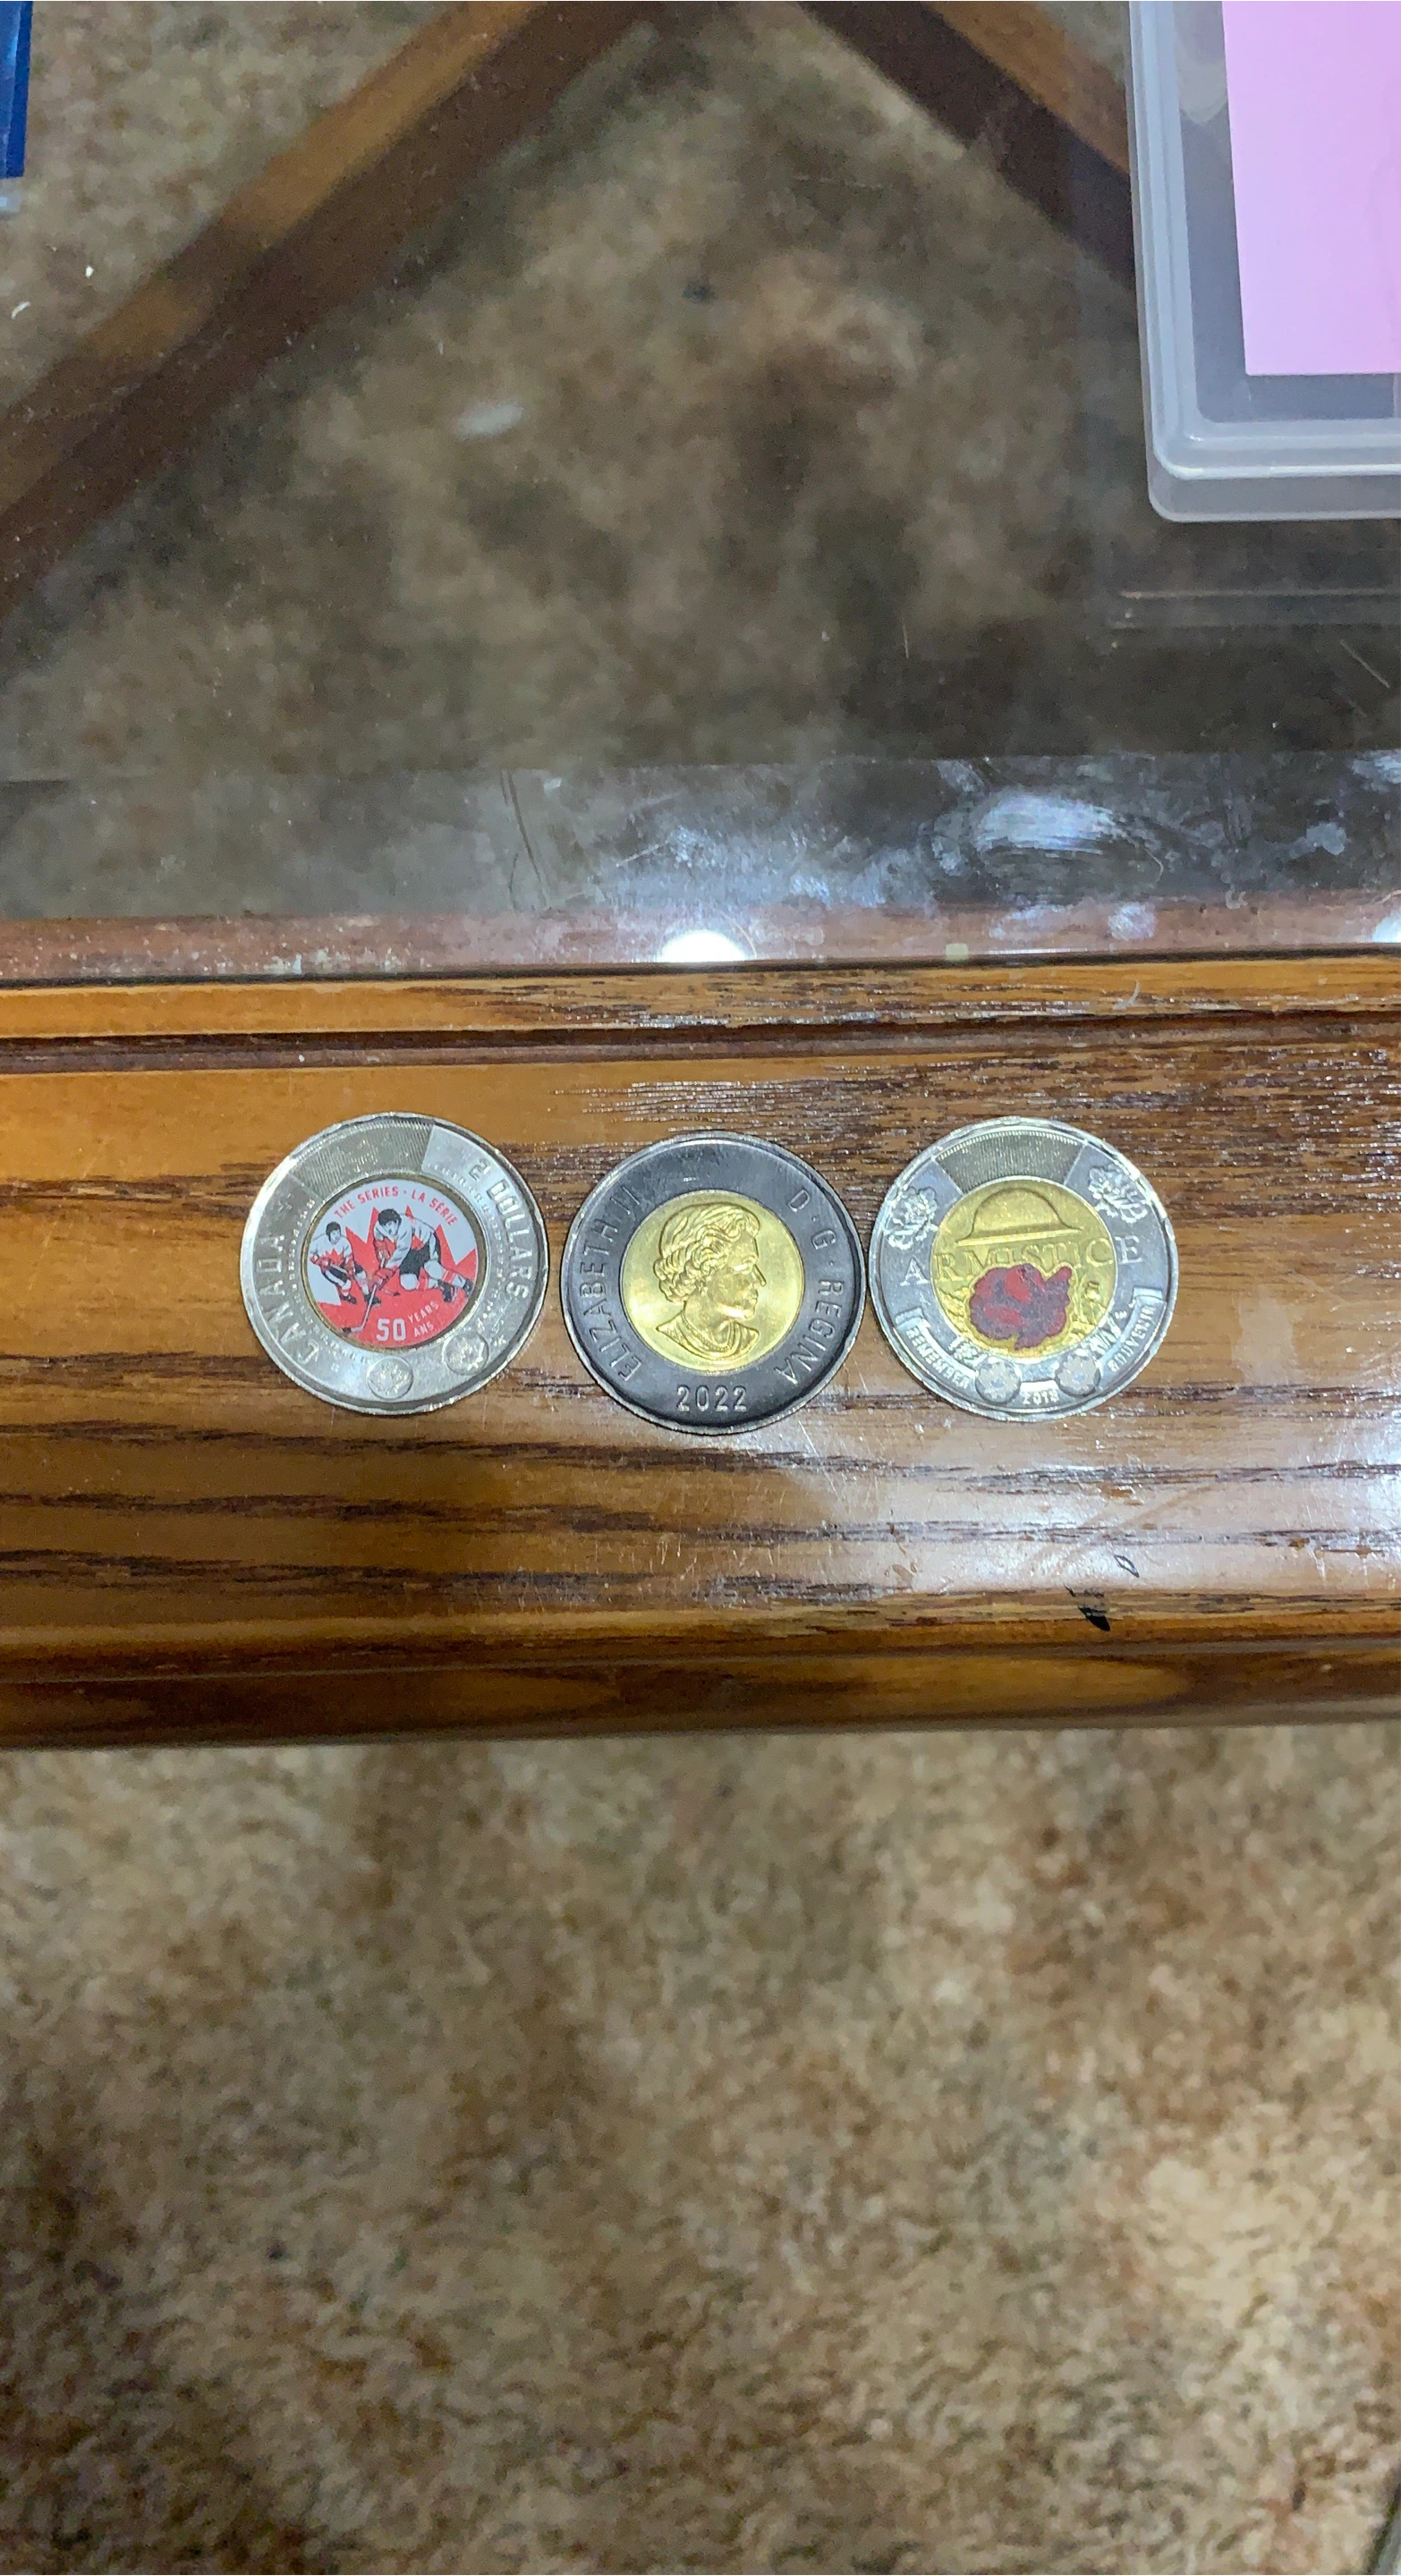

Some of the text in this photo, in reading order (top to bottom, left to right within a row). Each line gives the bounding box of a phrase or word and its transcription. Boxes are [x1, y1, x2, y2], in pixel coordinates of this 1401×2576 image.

[334, 1199, 355, 1218] THE
[358, 1186, 399, 1204] SERIES
[412, 1189, 426, 1203] LA
[469, 1157, 491, 1182] 2
[486, 1178, 533, 1299] DOLLARS
[899, 1235, 1142, 1286] ARMISTICE
[257, 1234, 319, 1364] CANADA
[407, 1301, 439, 1324] YEARS
[580, 1218, 642, 1381] ELIZABETH
[376, 1318, 406, 1342] 50
[413, 1321, 435, 1337] ANS
[774, 1279, 845, 1385] REGINA
[676, 1385, 747, 1412] 2022
